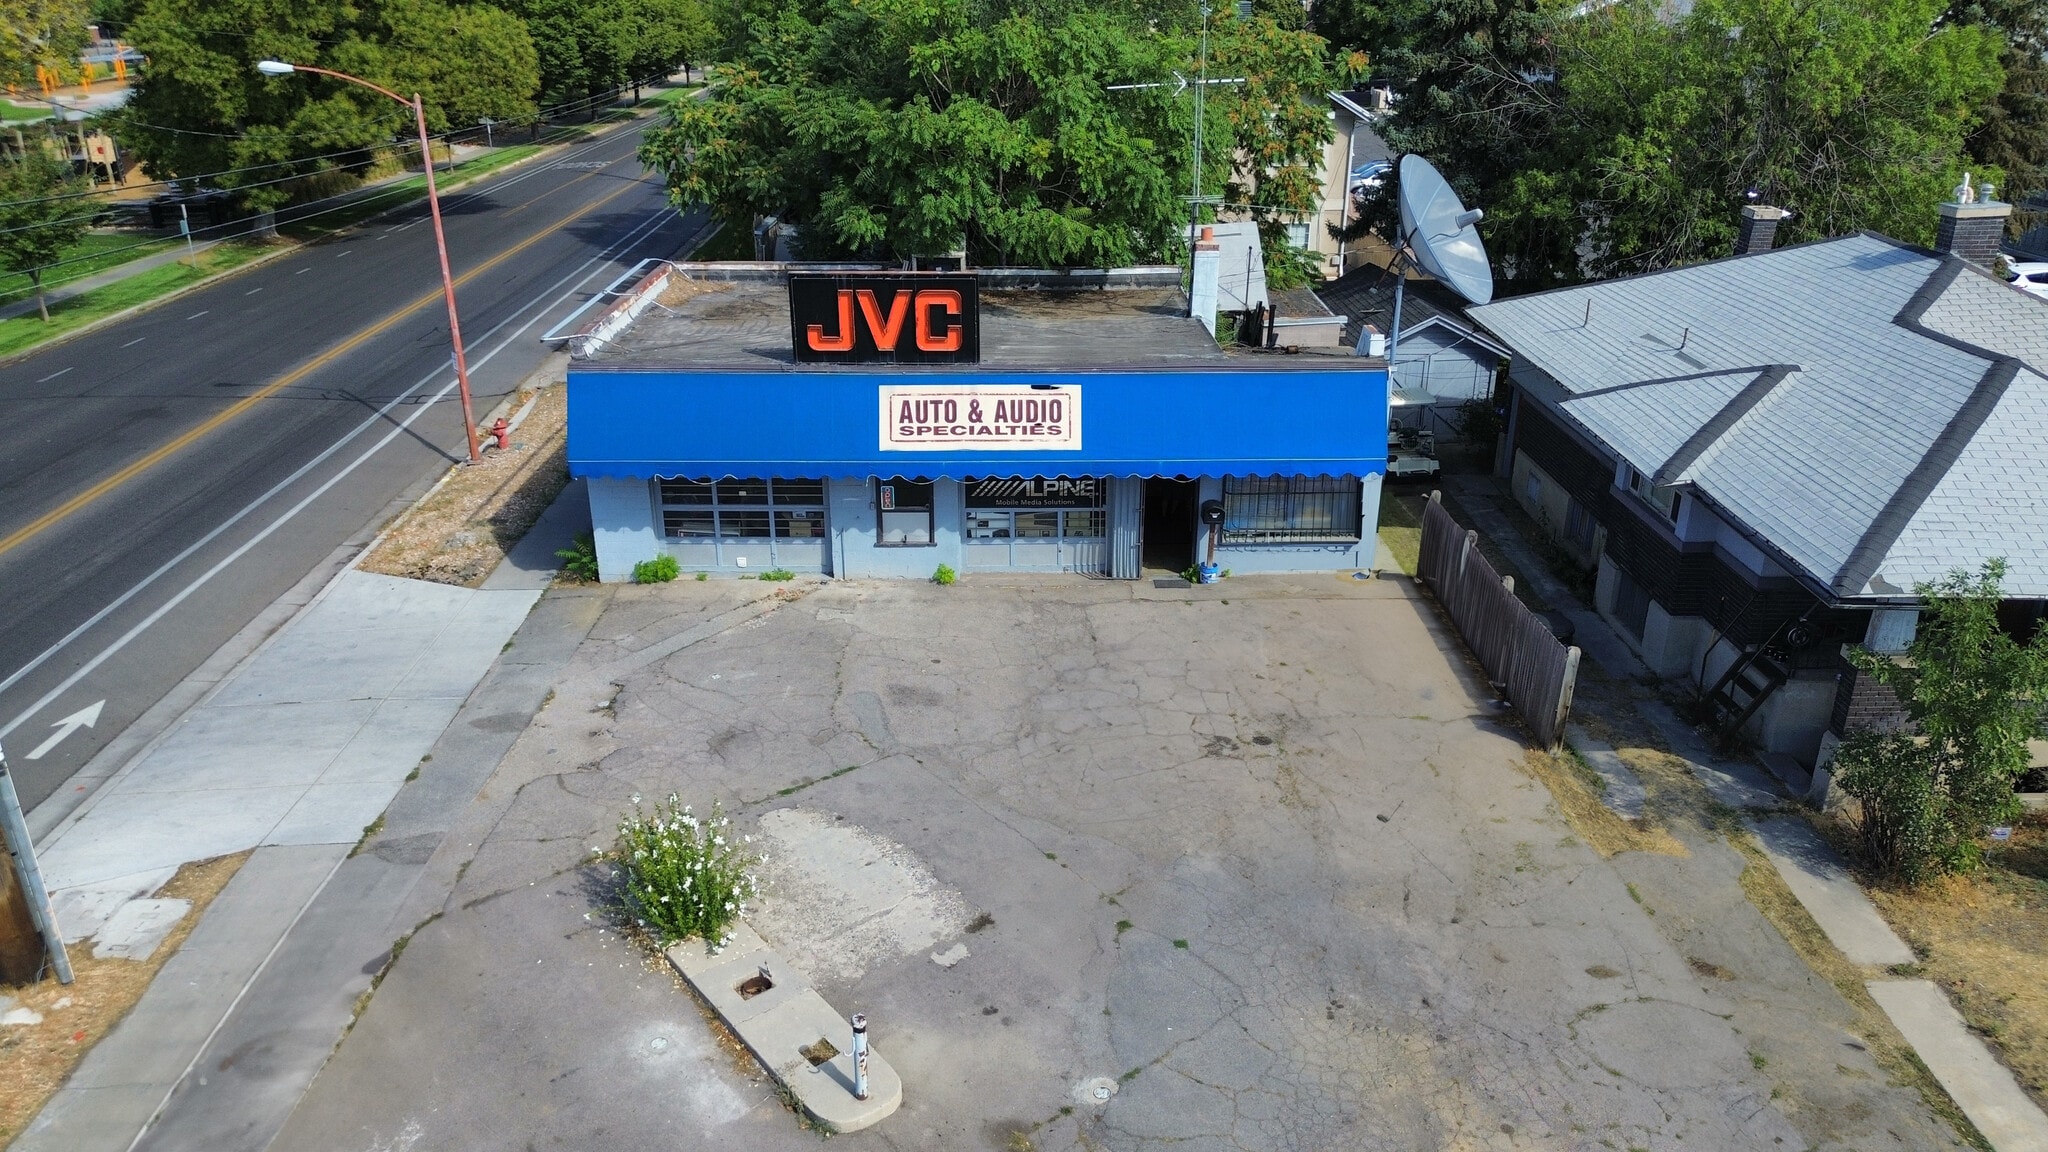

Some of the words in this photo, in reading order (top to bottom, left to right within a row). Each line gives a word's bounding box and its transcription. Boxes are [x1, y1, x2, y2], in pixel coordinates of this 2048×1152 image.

[807, 289, 962, 351] JVC
[899, 399, 957, 423] AUTO
[968, 398, 983, 423] &
[994, 399, 1062, 423] AUDIO
[899, 425, 1062, 436] SPECIALTIES
